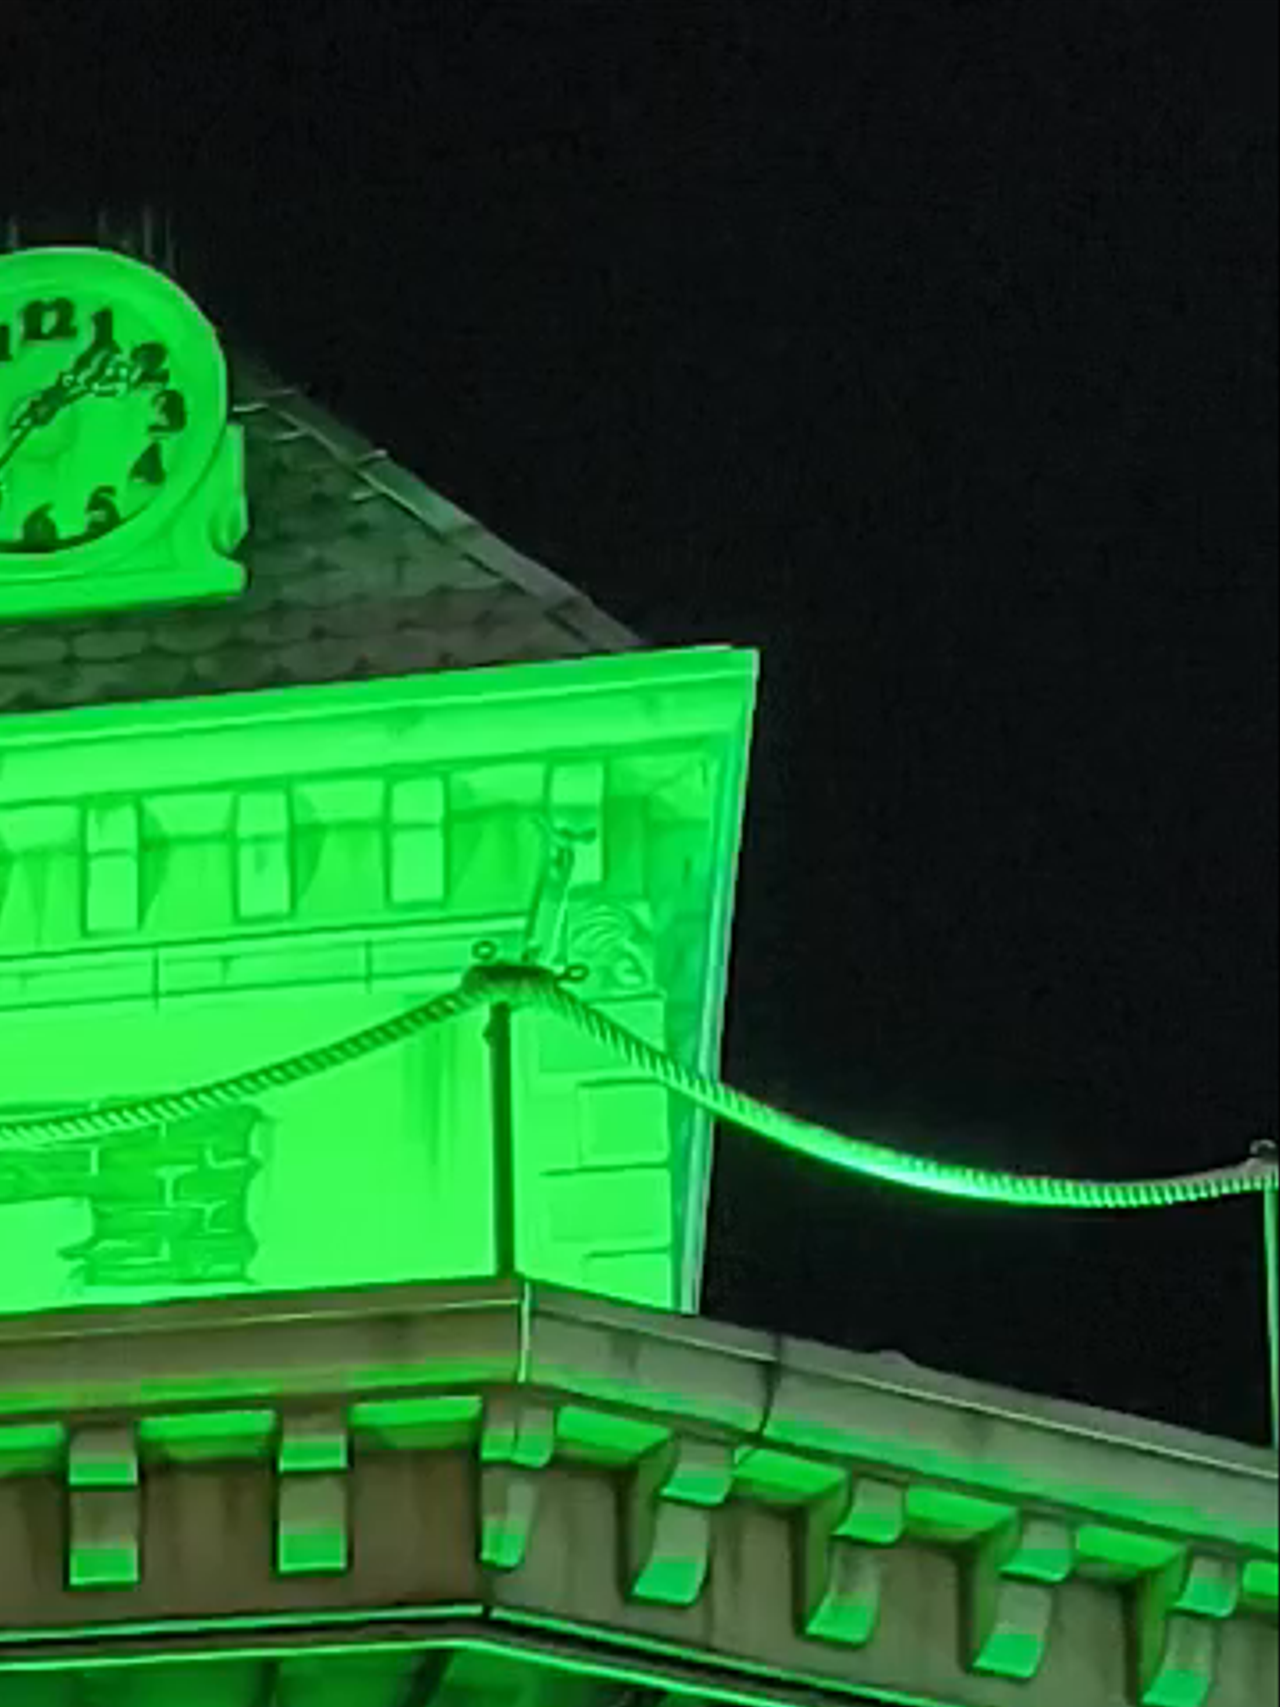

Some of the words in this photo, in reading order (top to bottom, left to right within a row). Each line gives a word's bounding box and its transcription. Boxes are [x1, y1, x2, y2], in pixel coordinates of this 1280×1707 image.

[22, 297, 77, 340] 12
[92, 307, 120, 352] 1
[128, 342, 170, 391] 2
[148, 390, 186, 433] 3
[128, 441, 167, 485] 4
[21, 503, 59, 547] 6
[87, 485, 121, 536] 5
